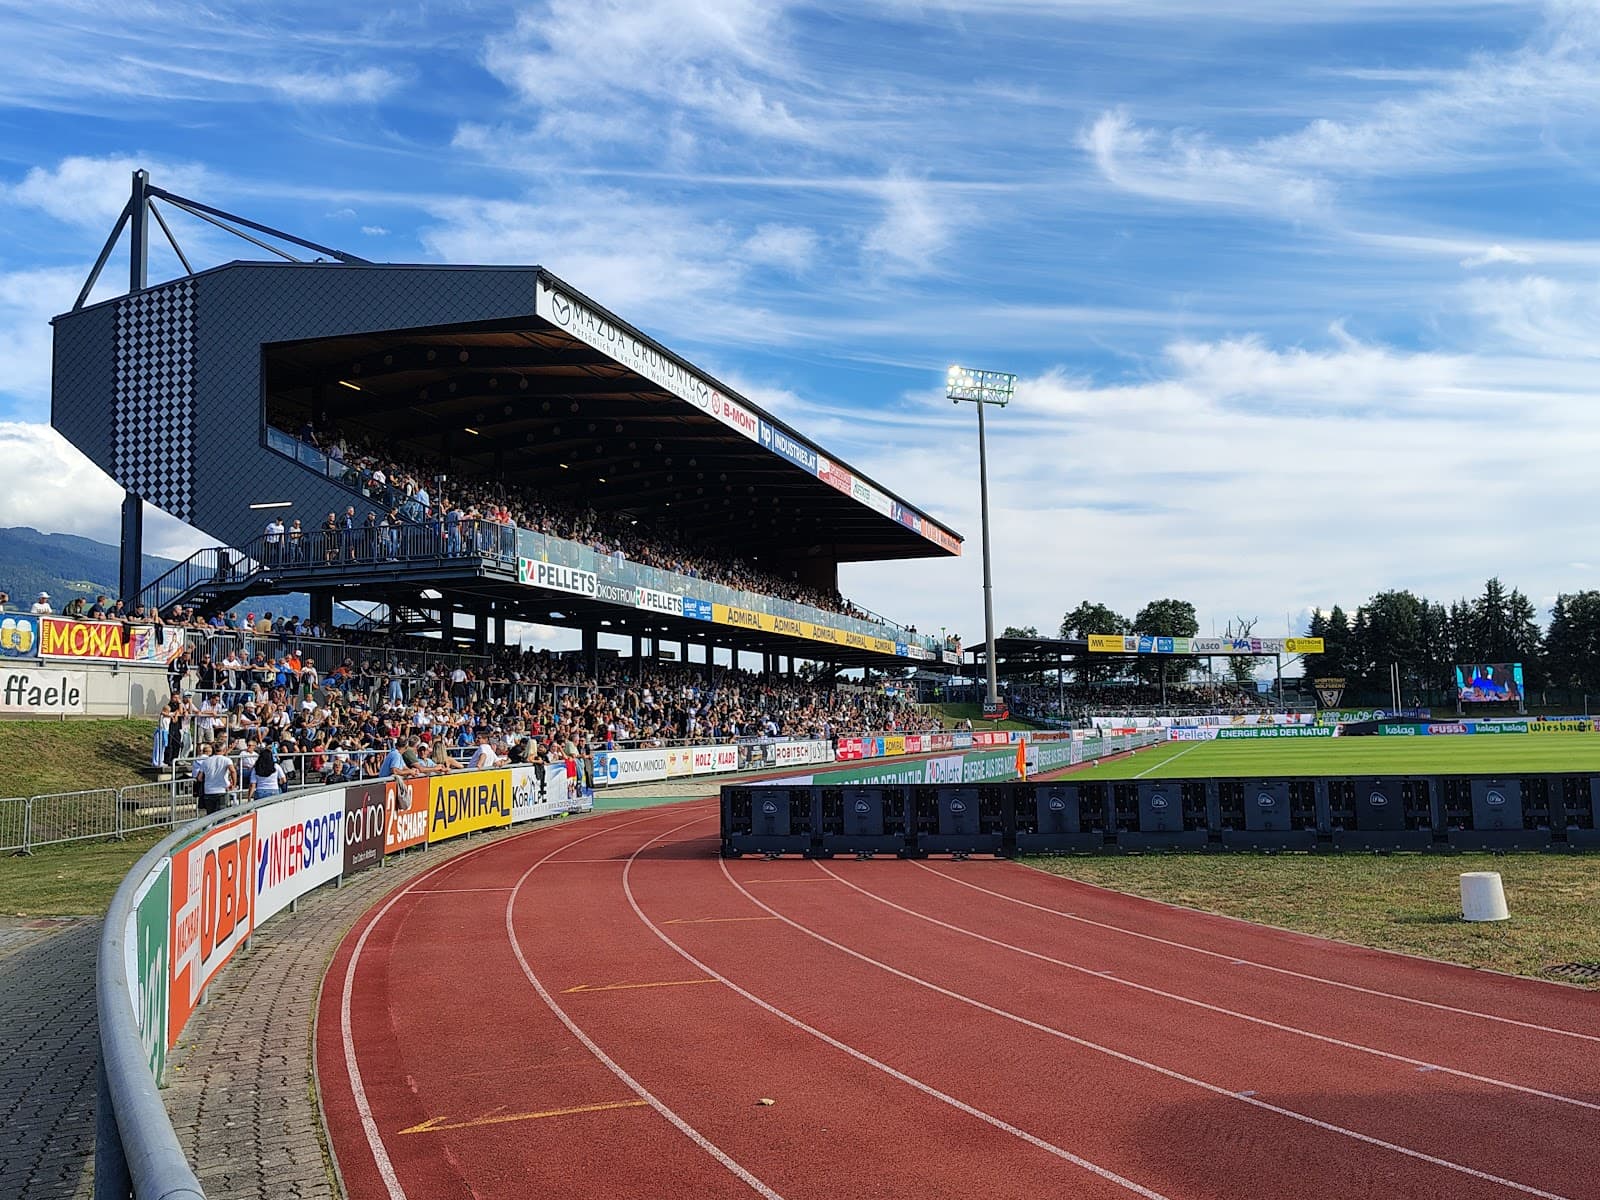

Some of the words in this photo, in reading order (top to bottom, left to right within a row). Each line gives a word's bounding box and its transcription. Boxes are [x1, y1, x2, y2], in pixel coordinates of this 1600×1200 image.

[572, 302, 625, 350] MAZDA
[632, 339, 696, 392] GRUNDNIG
[723, 402, 756, 433] B-MONT
[760, 420, 771, 447] hp
[774, 431, 817, 470] INDUSTRIES.AT
[538, 564, 595, 593] PELLETS
[596, 578, 636, 603] ÖKOSTROM
[647, 592, 682, 613] PELLETS
[727, 607, 762, 629] ADMIRAL
[773, 617, 803, 636] ADMIRAL
[812, 625, 837, 643] ADMIRAL
[846, 631, 866, 648] ADMIRAL
[874, 637, 894, 652] ADMIRAL
[1200, 640, 1220, 650] ASCO
[3, 674, 80, 707] ffaele
[1178, 729, 1213, 740] Pellets
[1220, 729, 1258, 737] ENERGIE
[1261, 728, 1277, 737] AUS
[1280, 728, 1298, 736] DER
[1300, 727, 1330, 736] NATUR
[1431, 724, 1466, 734] FUSSL
[1530, 721, 1592, 732] Wiesbauer
[695, 752, 711, 766] HOLZ
[717, 751, 736, 765] KLADE
[776, 746, 809, 759] ROBITSCH
[619, 760, 642, 774] KONICA
[643, 758, 667, 773] MINOLTA
[432, 779, 510, 833] ADMIRAL
[397, 810, 428, 842] SCHARF
[269, 810, 342, 889] INTERSPORT
[201, 833, 251, 966] OBI
